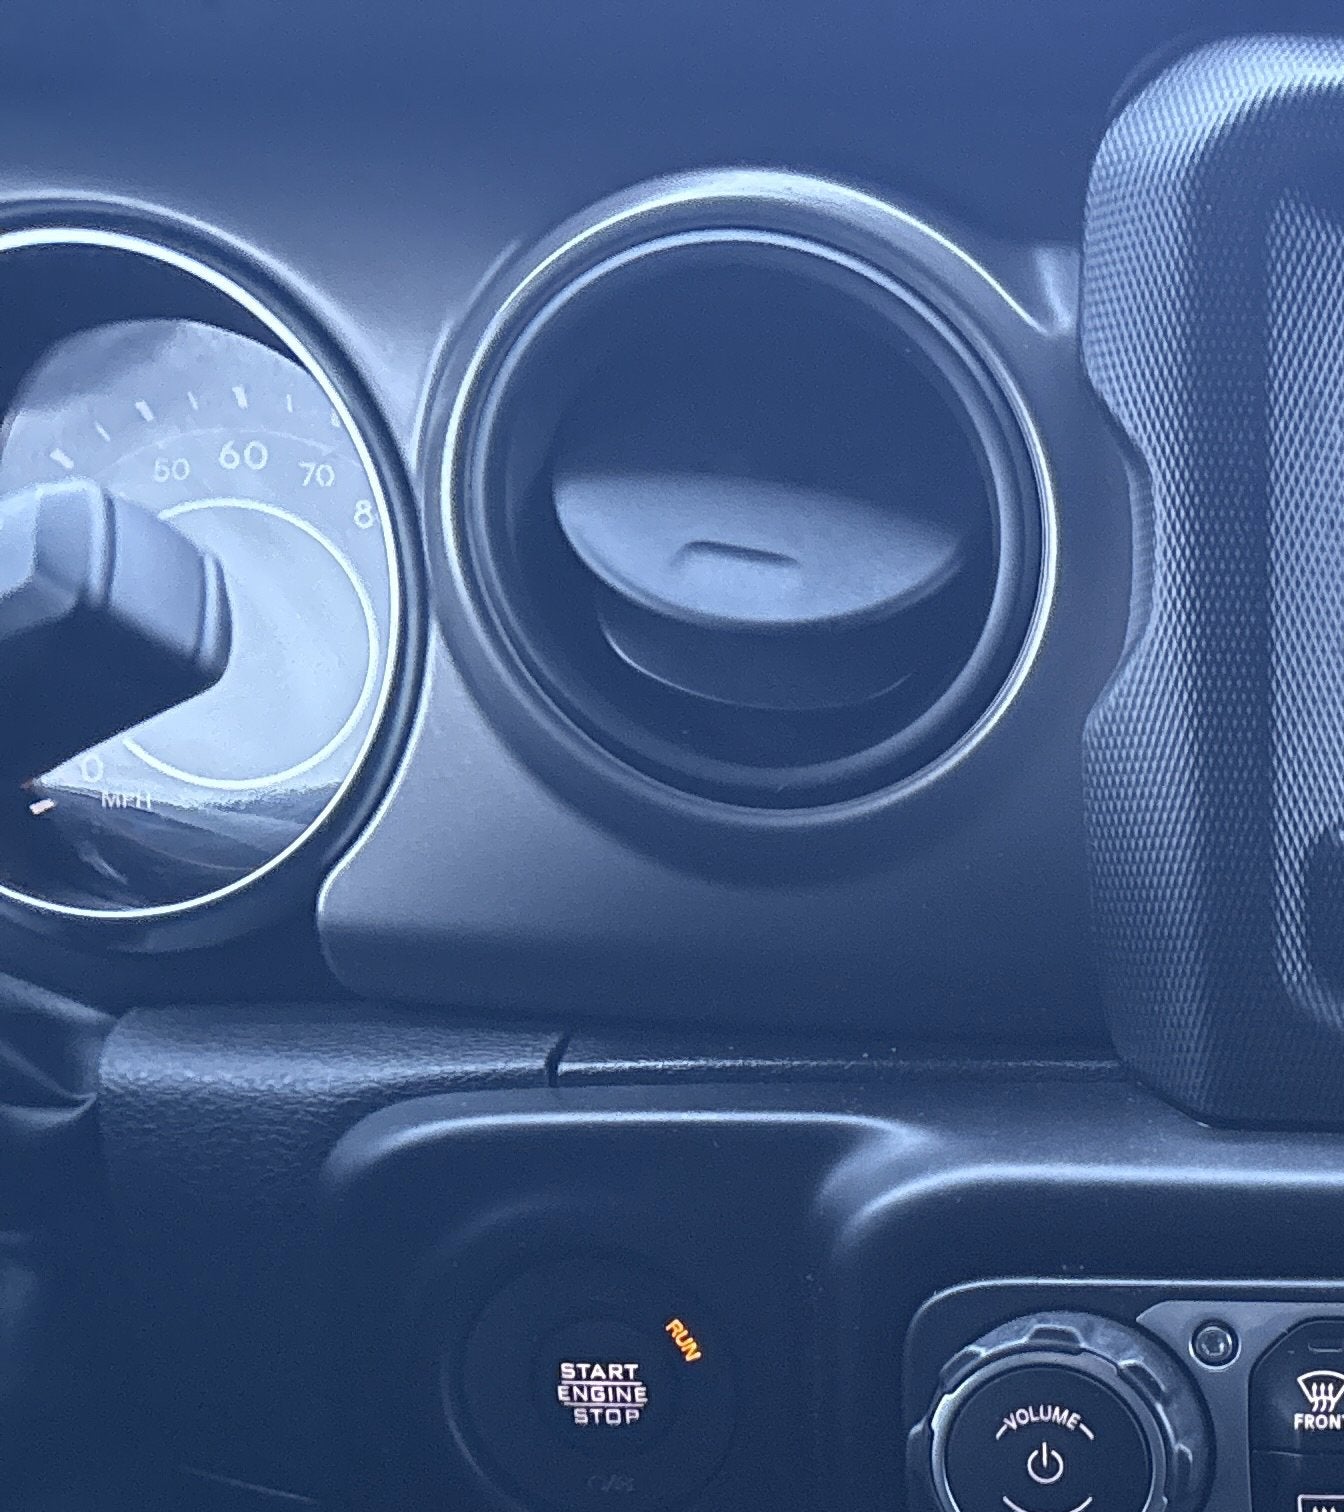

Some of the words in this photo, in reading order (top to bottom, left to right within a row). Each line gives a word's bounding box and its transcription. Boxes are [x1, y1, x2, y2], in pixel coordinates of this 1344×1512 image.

[217, 440, 269, 470] 60
[297, 461, 335, 487] 70
[665, 1319, 702, 1362] RUN
[560, 1362, 639, 1379] START
[557, 1385, 648, 1403] ENGINE
[573, 1408, 640, 1425] STOP
[1002, 1404, 1083, 1432] VOLUME
